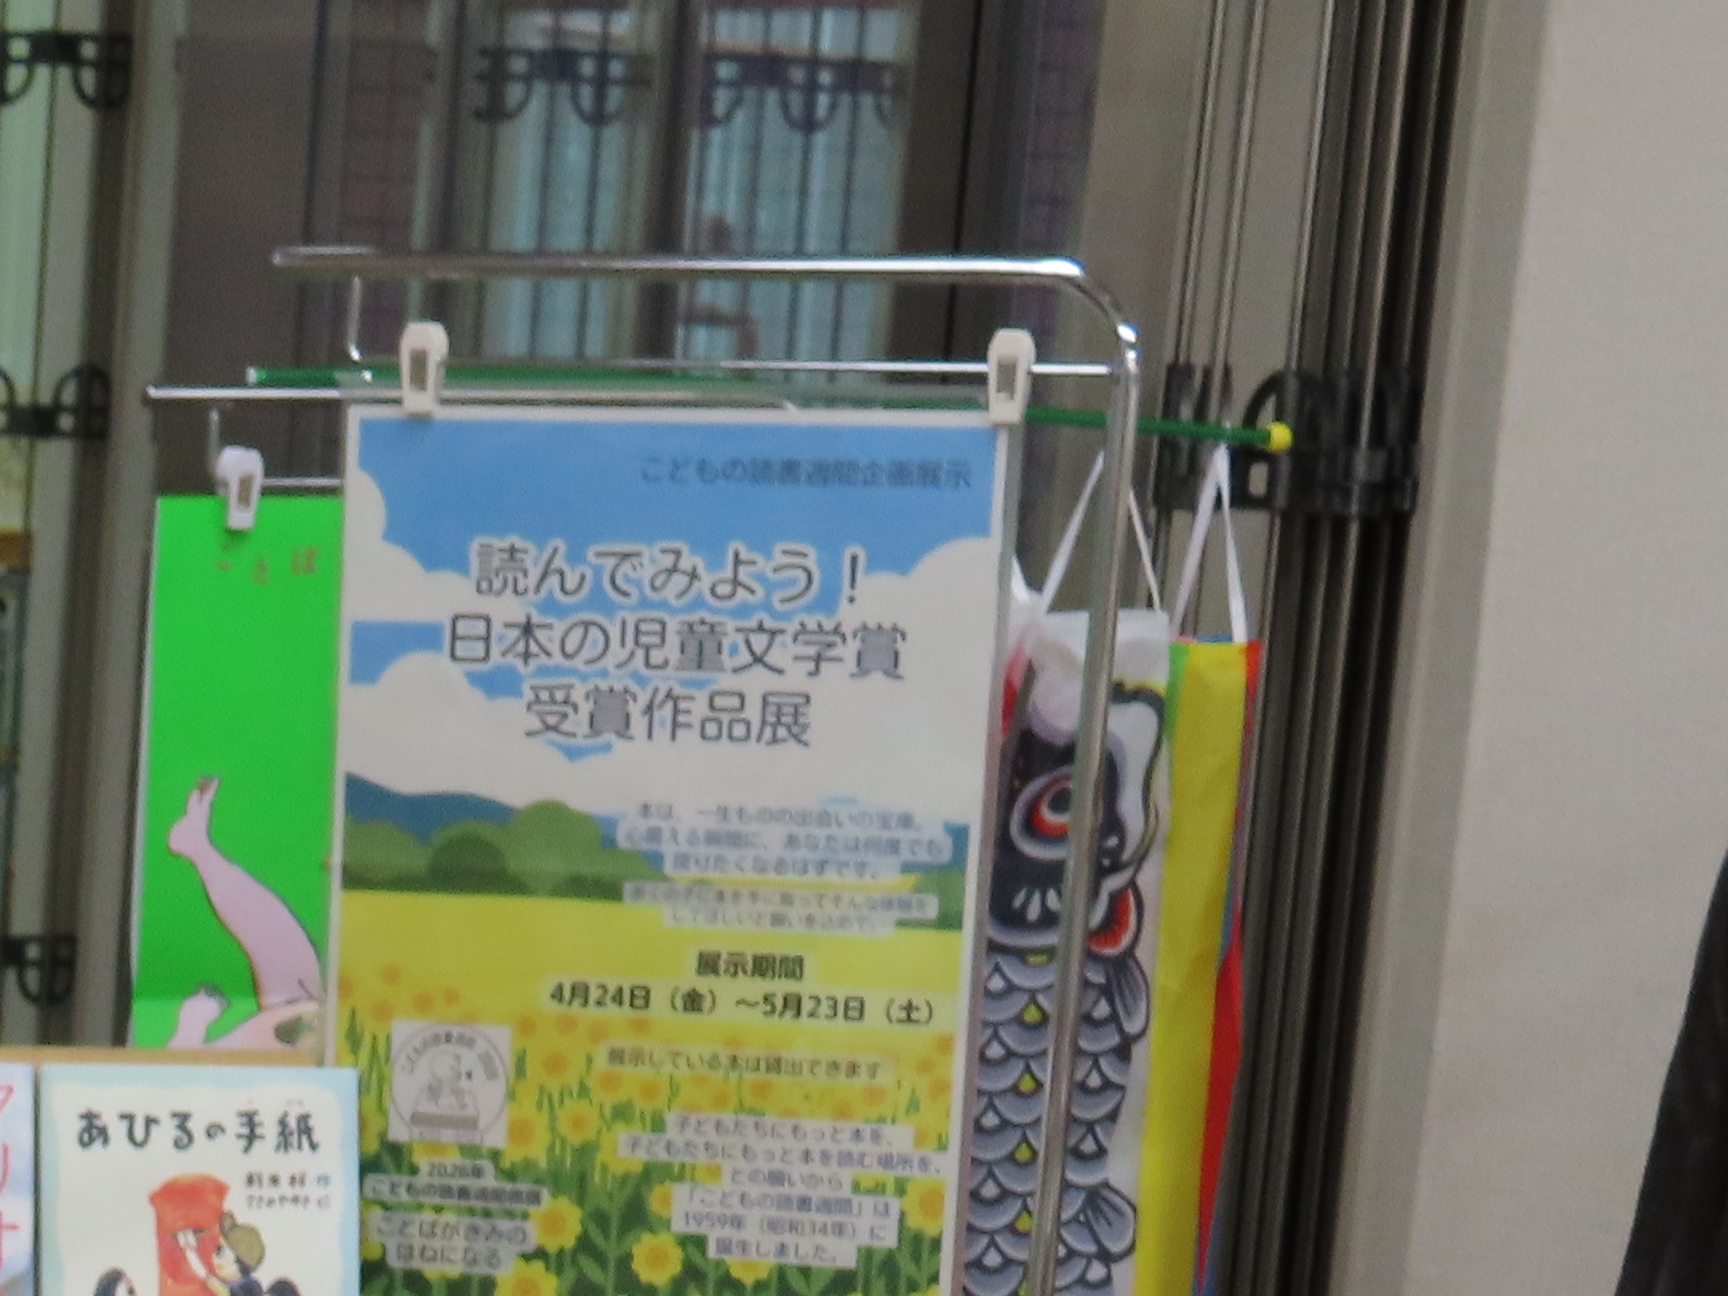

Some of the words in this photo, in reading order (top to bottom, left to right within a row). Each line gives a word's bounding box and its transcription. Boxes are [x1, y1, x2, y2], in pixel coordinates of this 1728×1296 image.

[643, 457, 972, 488] こどもの読書週間企画展示
[476, 541, 861, 603] 読んでみよう！
[450, 614, 907, 679] 日本の児童文学賞
[525, 683, 812, 747] 受賞作品展
[696, 950, 805, 981] 展示期間
[76, 1108, 321, 1155] あひるの手紙
